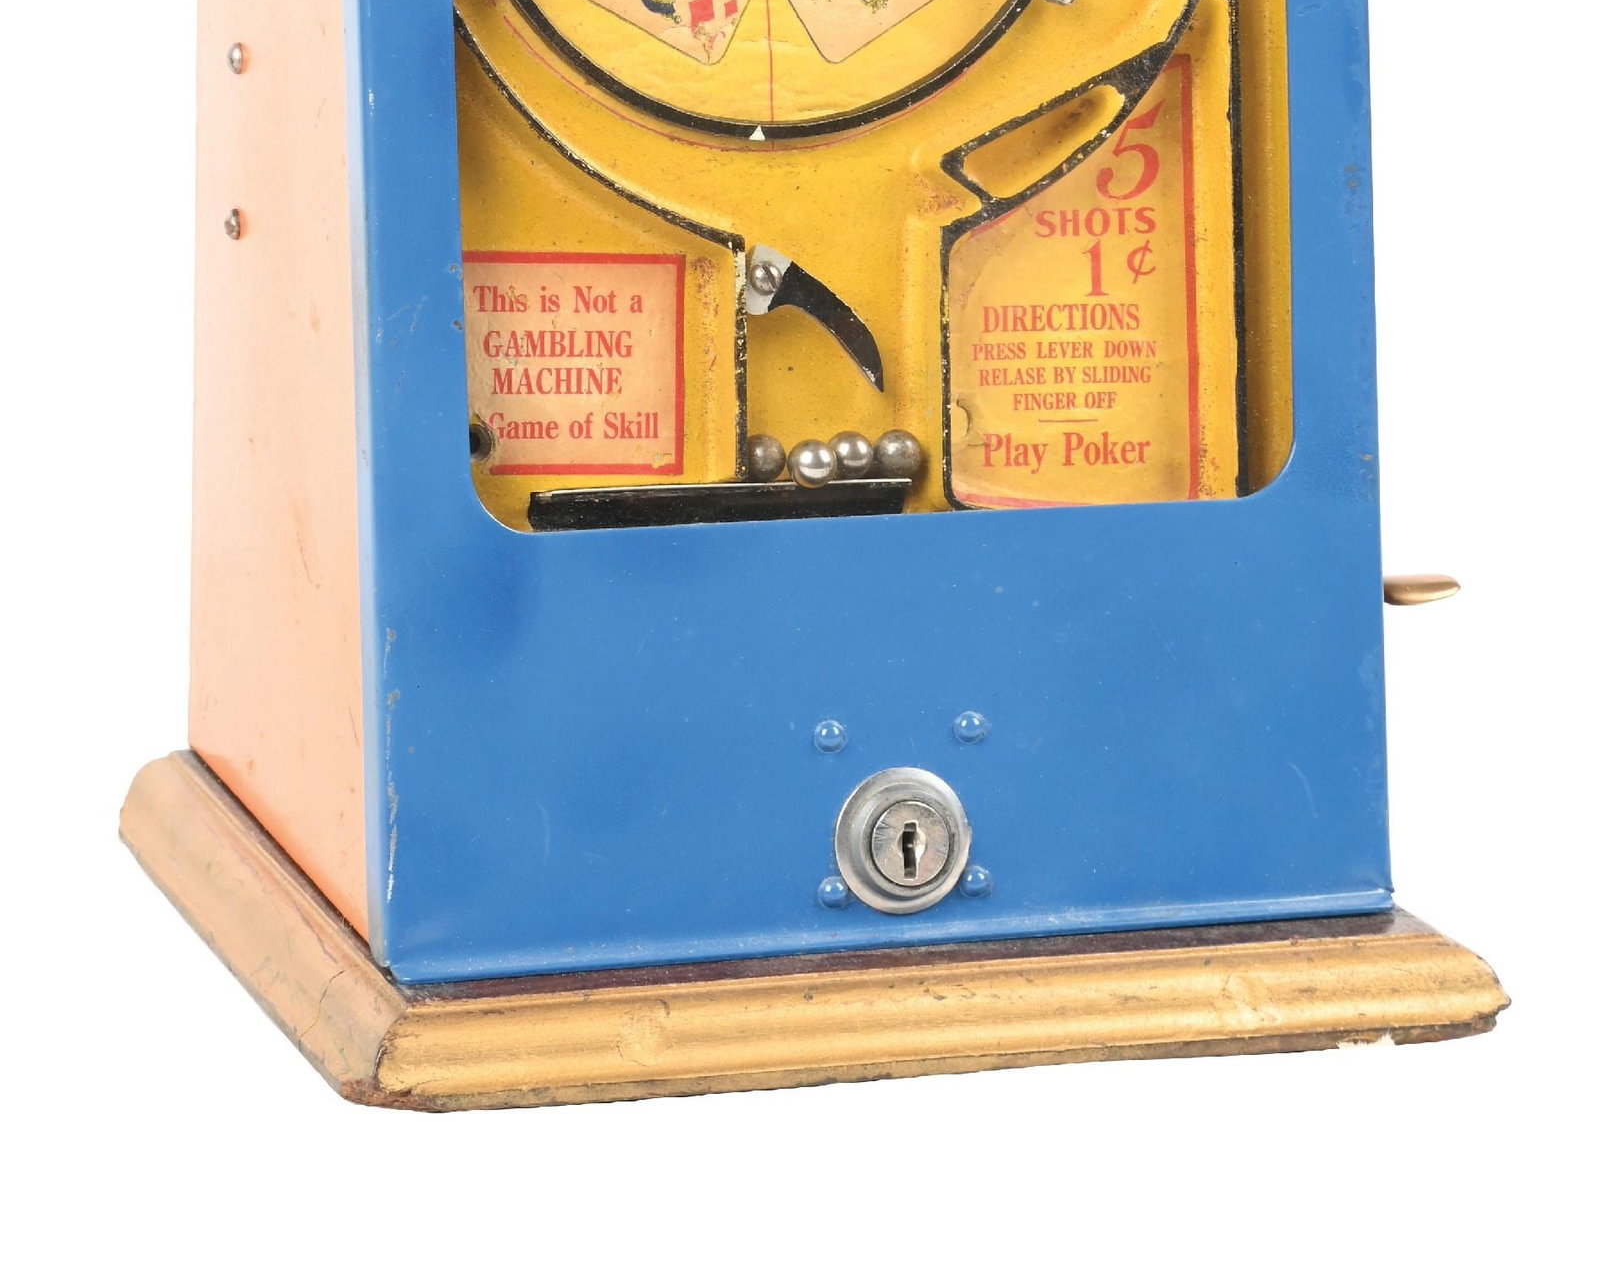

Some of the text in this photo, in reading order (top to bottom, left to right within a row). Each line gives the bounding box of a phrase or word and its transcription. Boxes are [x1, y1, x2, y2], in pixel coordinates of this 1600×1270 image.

[1096, 99, 1166, 201] 5
[1035, 207, 1157, 238] SHOTS
[473, 285, 643, 314] This is Not a
[982, 303, 1140, 333] DIRECTIONS
[483, 330, 633, 358] GAMBLING
[972, 340, 1157, 362] PRESS LEVER DOWN
[491, 367, 623, 395] MACHINE
[978, 365, 1151, 387] RELASE BY SLIDING
[1013, 391, 1118, 411] FINGER OFF
[488, 412, 660, 440] Game of Skill
[981, 431, 1152, 474] Play Poker
